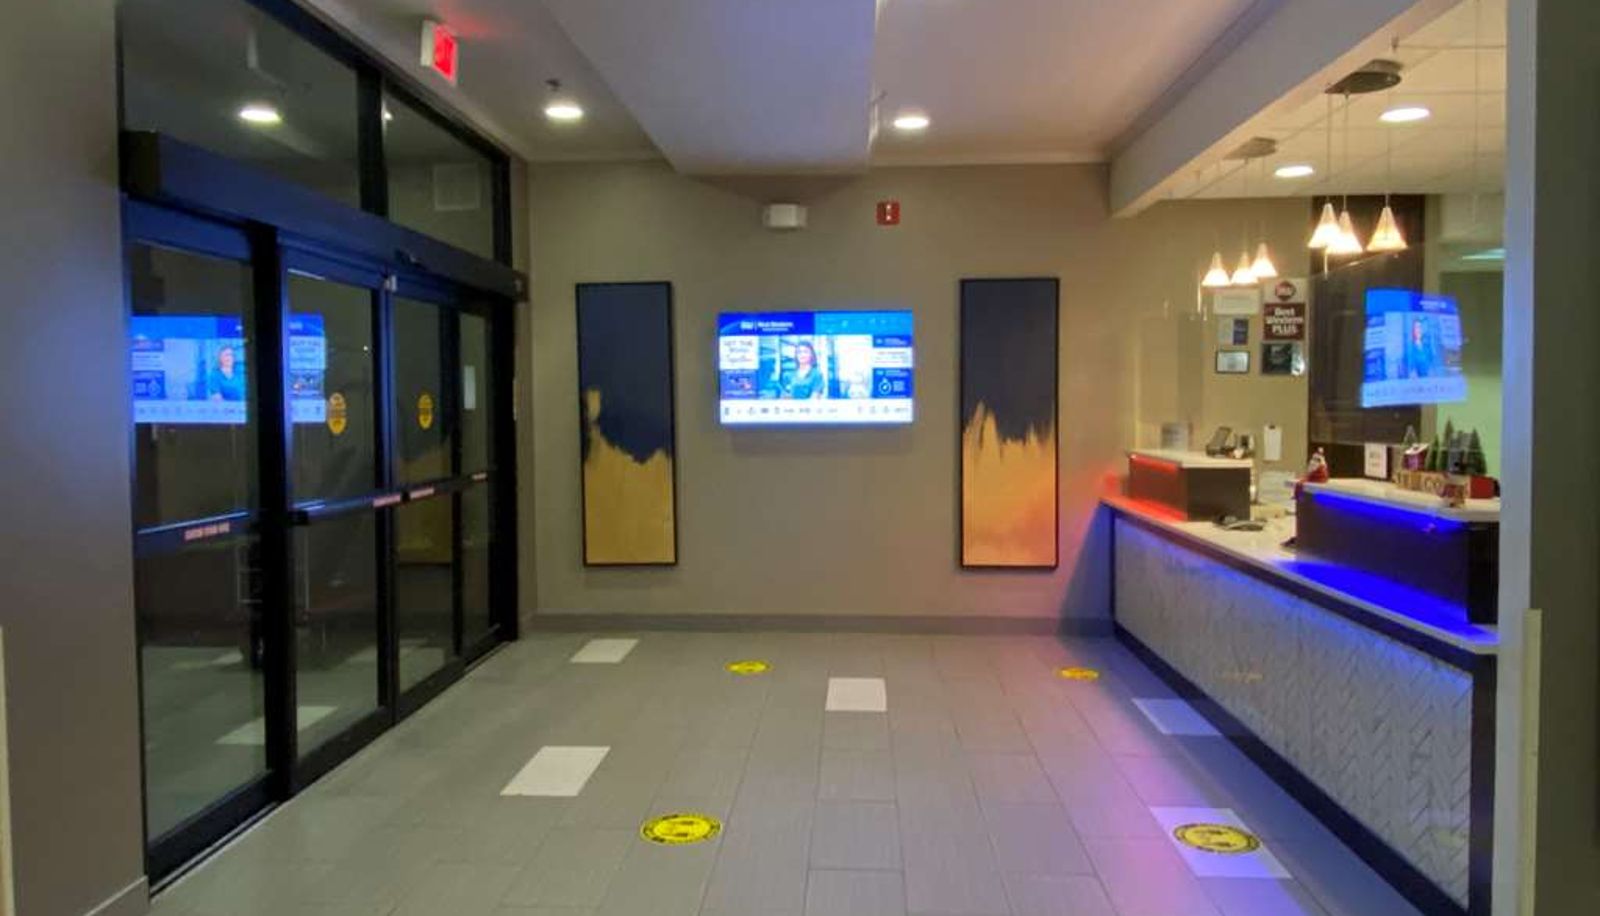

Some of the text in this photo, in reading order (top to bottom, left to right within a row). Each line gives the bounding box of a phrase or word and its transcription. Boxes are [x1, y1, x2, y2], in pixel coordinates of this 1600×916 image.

[1274, 307, 1295, 316] Best
[1265, 316, 1303, 325] Western
[1272, 324, 1298, 336] PLUS
